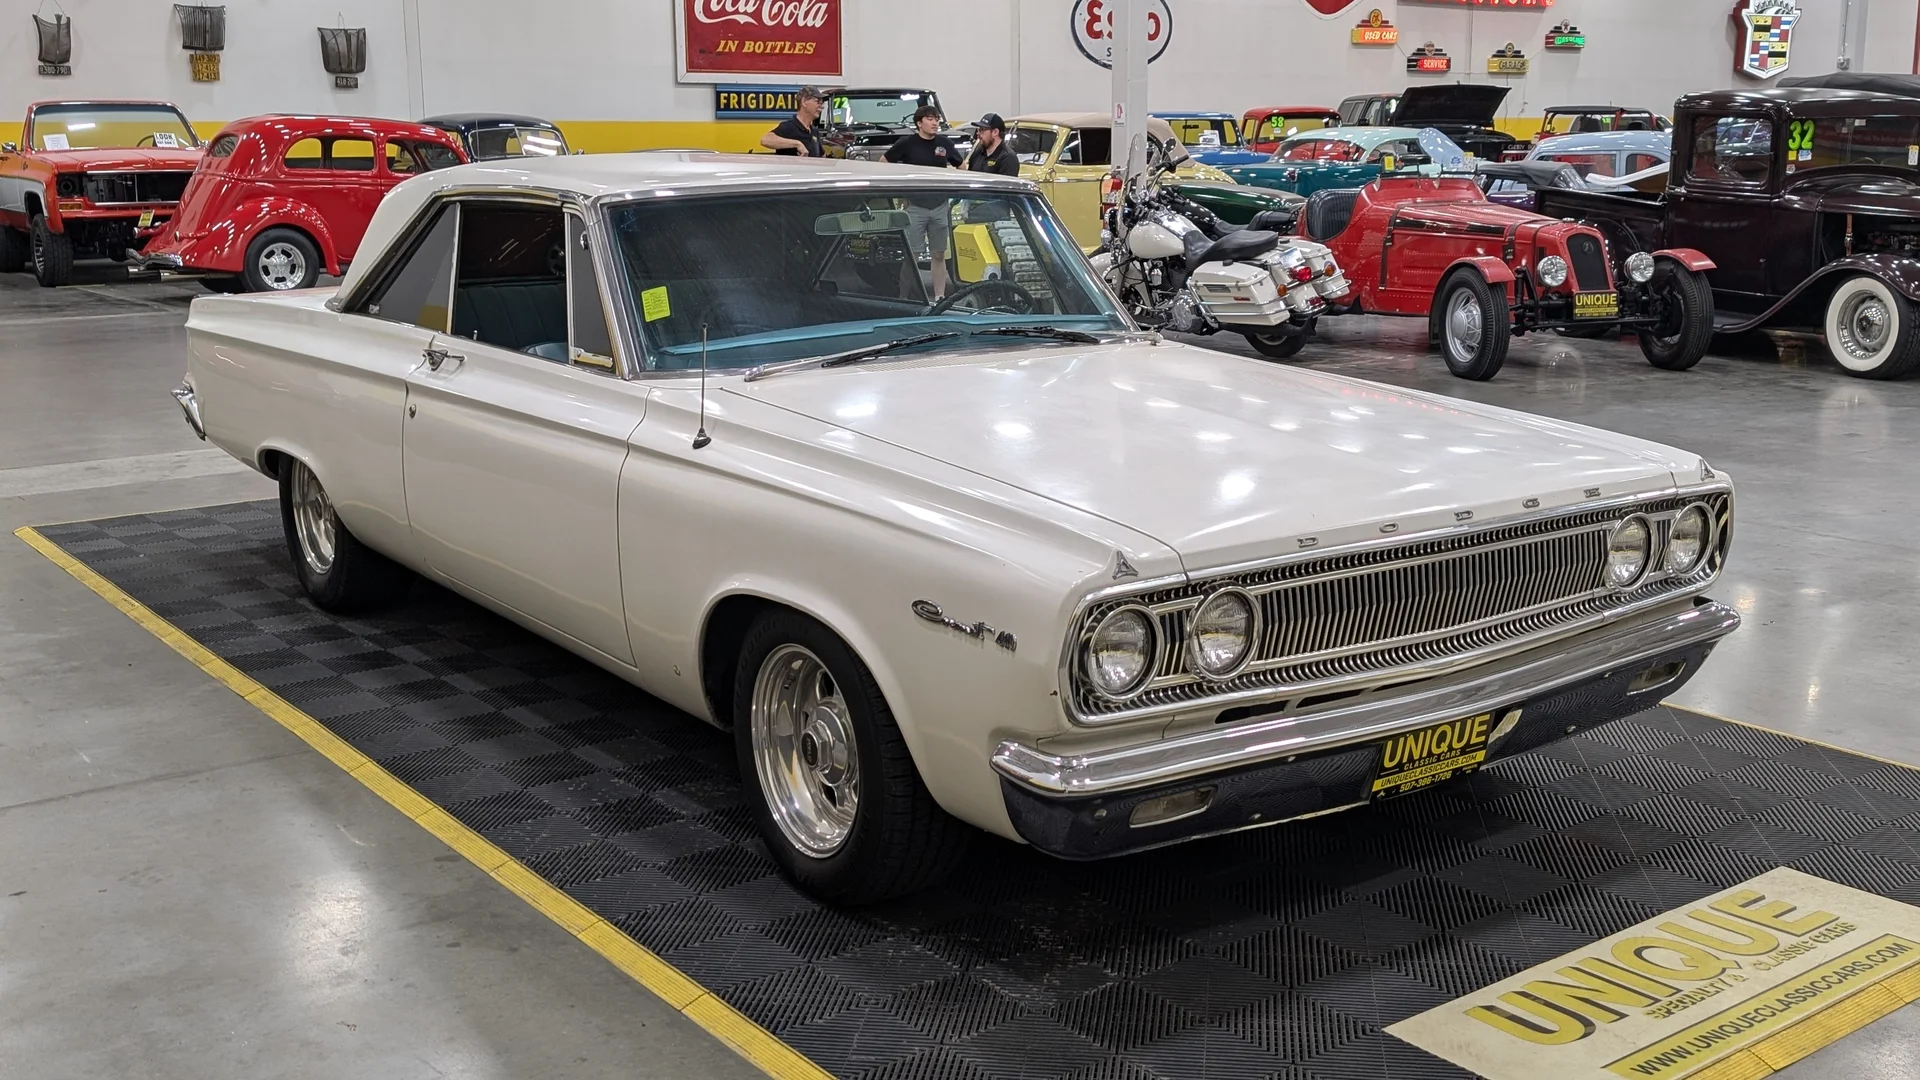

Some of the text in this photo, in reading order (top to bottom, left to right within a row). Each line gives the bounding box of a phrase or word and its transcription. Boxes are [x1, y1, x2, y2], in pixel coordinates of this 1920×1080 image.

[694, 0, 828, 27] CocaCola
[716, 40, 816, 55] IN BOTTLES
[1364, 31, 1397, 40] USED CARS
[1423, 59, 1447, 69] SERVICE
[833, 97, 850, 108] 72
[1271, 116, 1284, 127] 58
[1788, 120, 1815, 150] 32
[1575, 293, 1617, 306] UNIQUE
[1383, 714, 1490, 768] UNIQUE
[1380, 754, 1478, 787] UNIQUECLASSICCARS.COM
[1404, 749, 1461, 770] CLASSIC CARS
[1462, 889, 1840, 1045] UNIQUE
[1644, 978, 1734, 1020] SPECIALTY
[1752, 940, 1817, 972] CLASSIC
[1812, 921, 1858, 945] CARS
[1630, 942, 1913, 1076] WWW.UNIQUECLASSICCARS.COM
